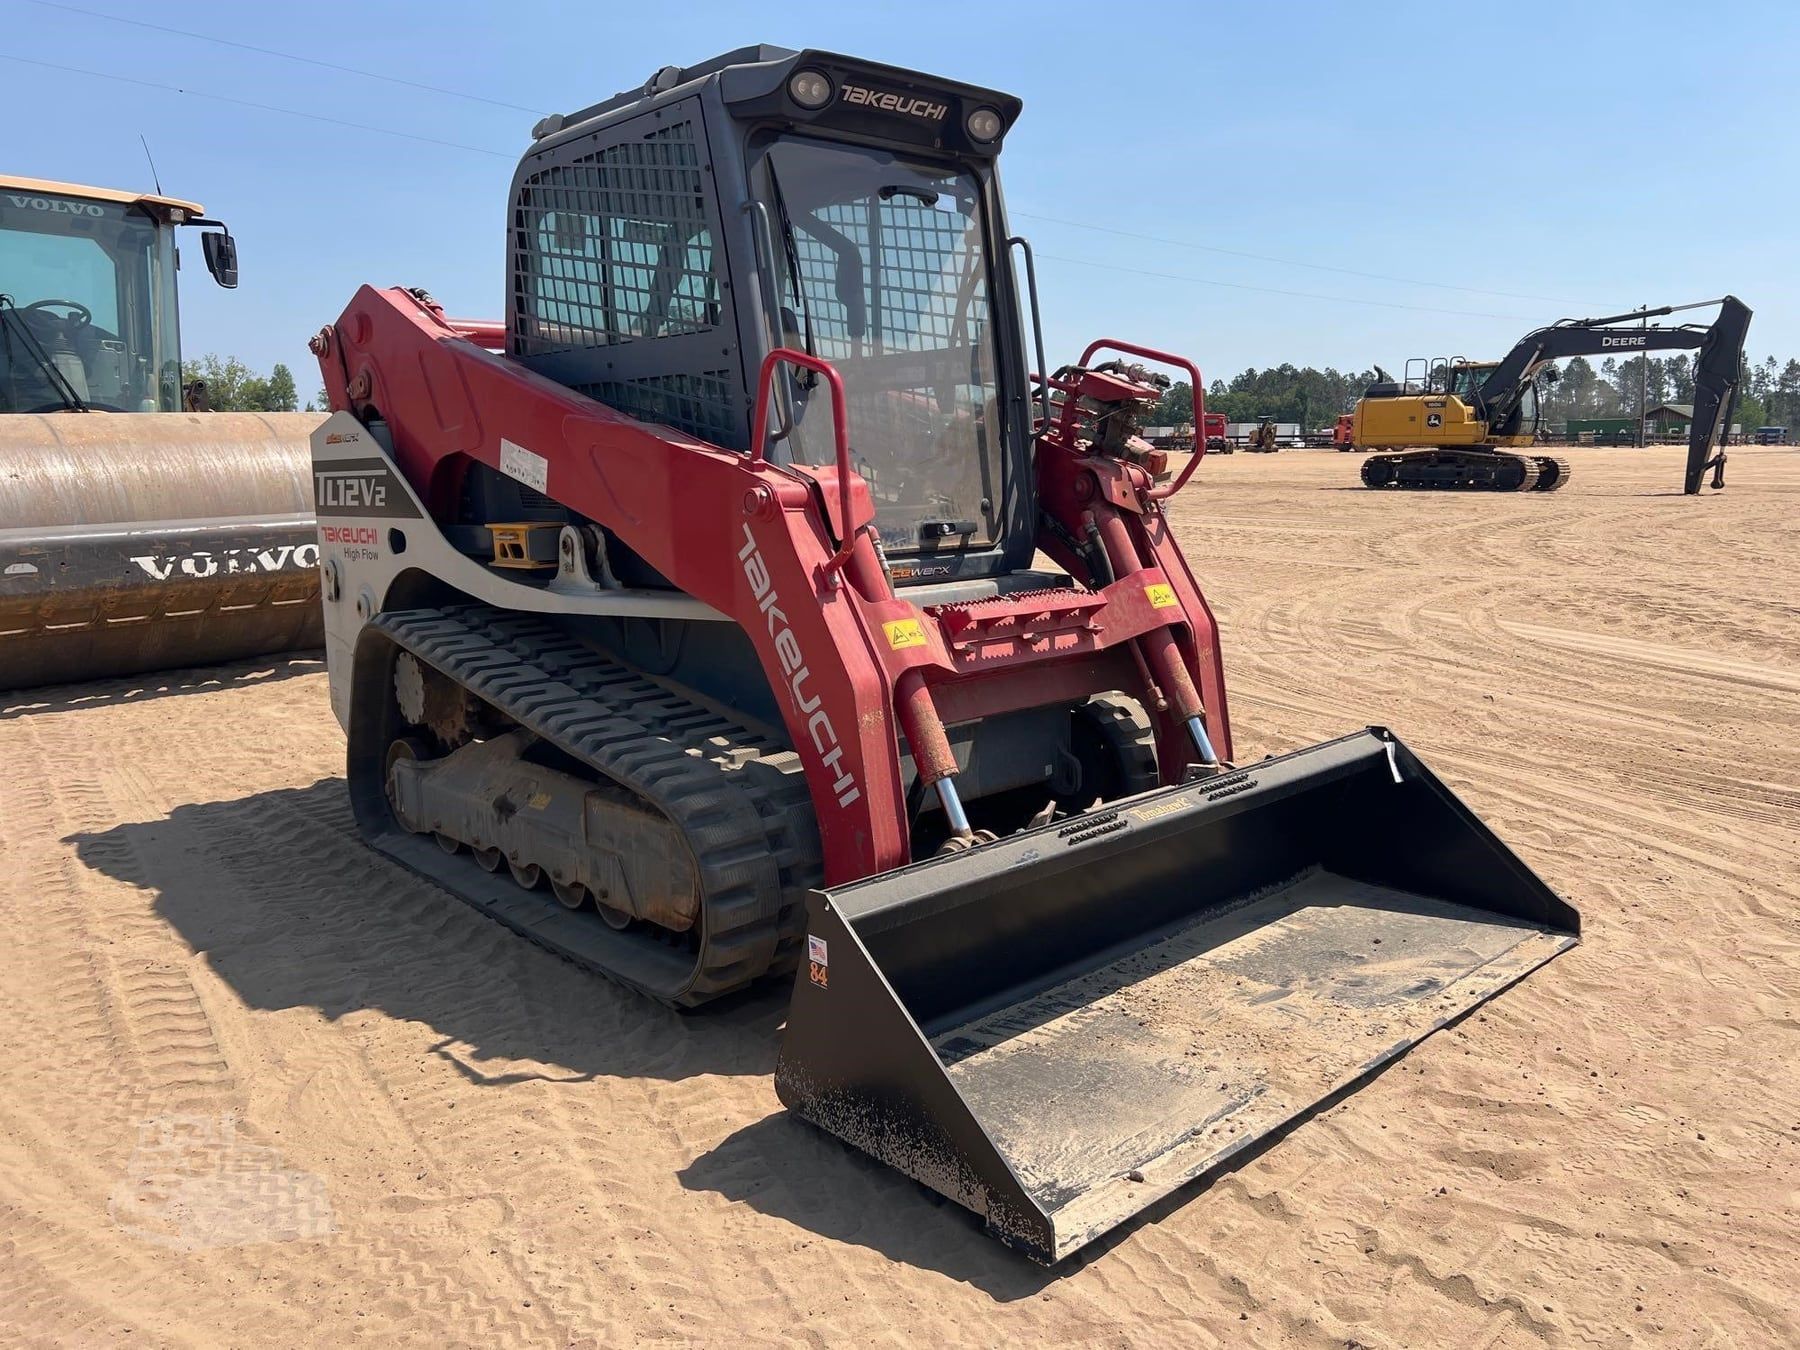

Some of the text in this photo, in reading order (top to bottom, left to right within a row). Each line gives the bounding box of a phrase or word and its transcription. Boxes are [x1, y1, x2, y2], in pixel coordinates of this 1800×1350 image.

[840, 84, 948, 121] TAKEUCHI
[7, 194, 105, 217] VOLVO
[1602, 336, 1647, 347] DEERE
[314, 469, 387, 507] TL12V2
[321, 526, 378, 545] TAKEUCHI
[129, 543, 320, 581] VOLVO
[344, 547, 379, 561] High Flow
[738, 522, 861, 809] TAKEUCHI
[1129, 797, 1192, 821] Tomahawk
[810, 961, 828, 987] 84
